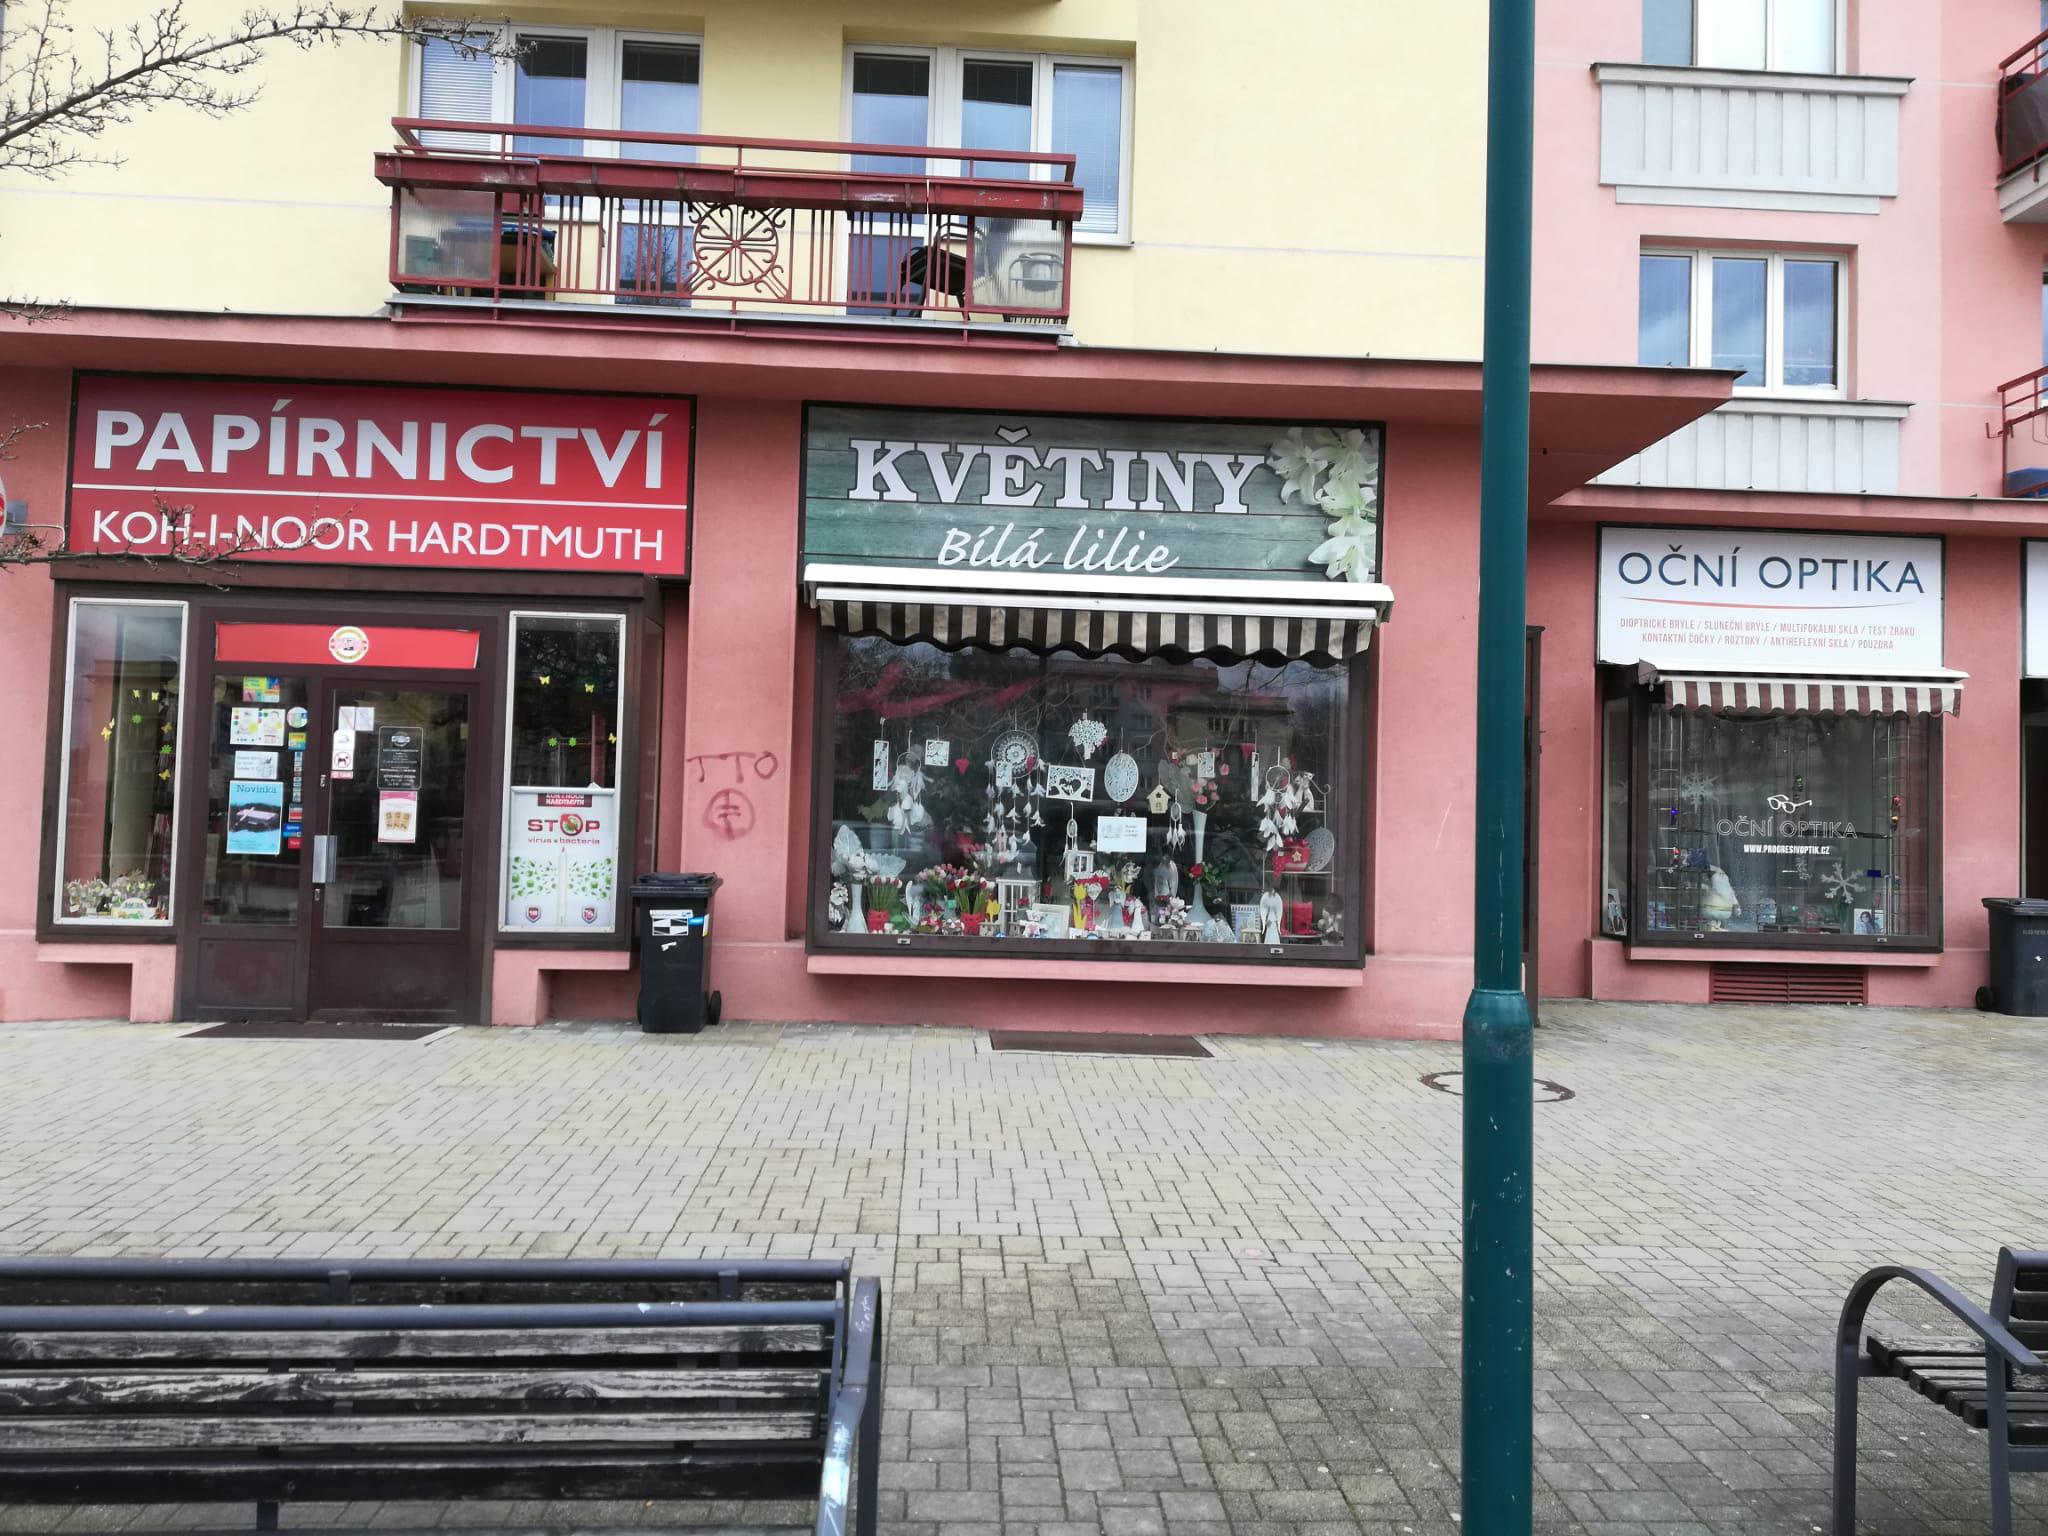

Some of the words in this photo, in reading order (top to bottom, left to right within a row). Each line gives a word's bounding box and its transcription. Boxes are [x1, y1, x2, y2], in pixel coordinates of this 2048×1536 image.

[93, 398, 669, 490] PAPÍRNICTVÍ
[848, 423, 1268, 515] KVĚTINY
[92, 509, 372, 553] KOH-I-NOOR
[388, 519, 665, 561] HARDTMUTH
[937, 522, 1051, 568] Bílá
[1062, 525, 1180, 574] lilie
[1618, 544, 1741, 588] OČNÍ
[1758, 556, 1926, 594] OPTIKA
[1724, 634, 1760, 646] ROZTOKY
[1828, 638, 1848, 649] SKLA
[1858, 639, 1894, 650] POUZDRA
[1838, 624, 1859, 635] SKLA
[1889, 626, 1915, 637] ZRAKU
[236, 784, 278, 794] Novinka
[527, 813, 600, 837] STOP
[1716, 815, 1774, 837] OČNÍ
[1779, 820, 1858, 839] OPTIKA
